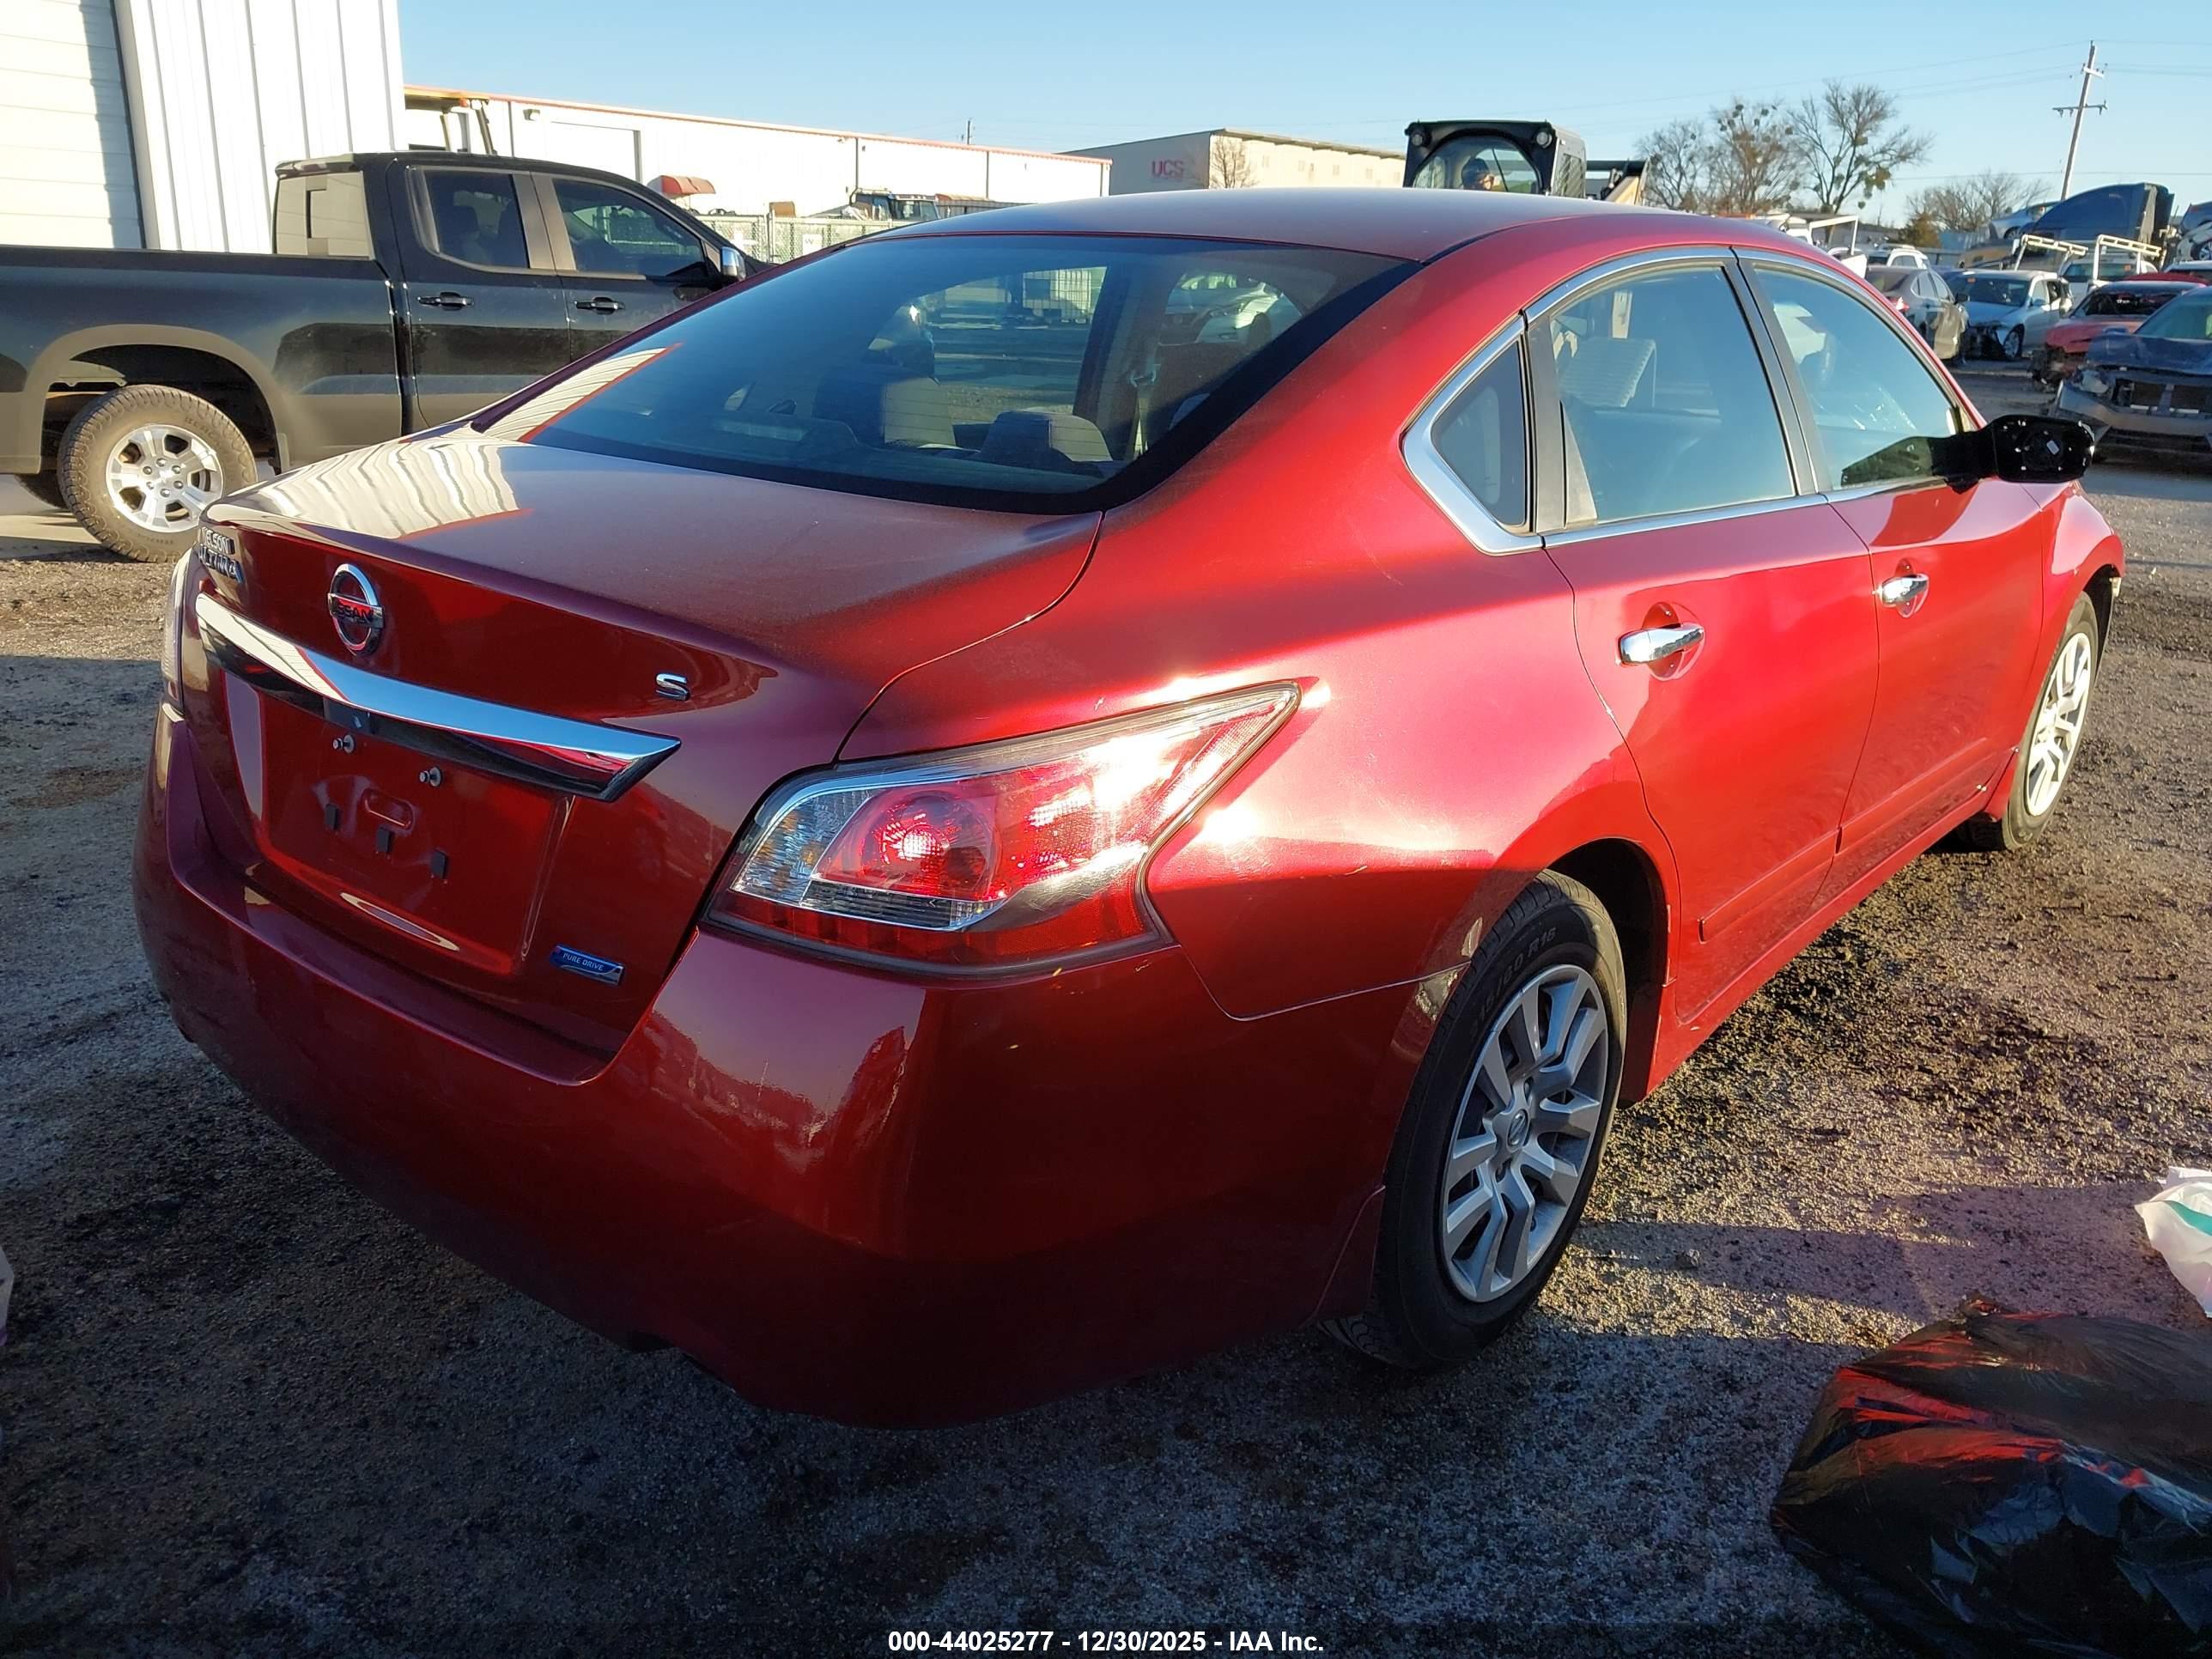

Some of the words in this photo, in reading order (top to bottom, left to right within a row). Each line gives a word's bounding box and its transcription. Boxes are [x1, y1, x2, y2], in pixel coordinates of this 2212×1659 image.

[655, 672, 690, 701] S
[562, 952, 581, 964] PURE
[583, 958, 605, 971] DRIVE
